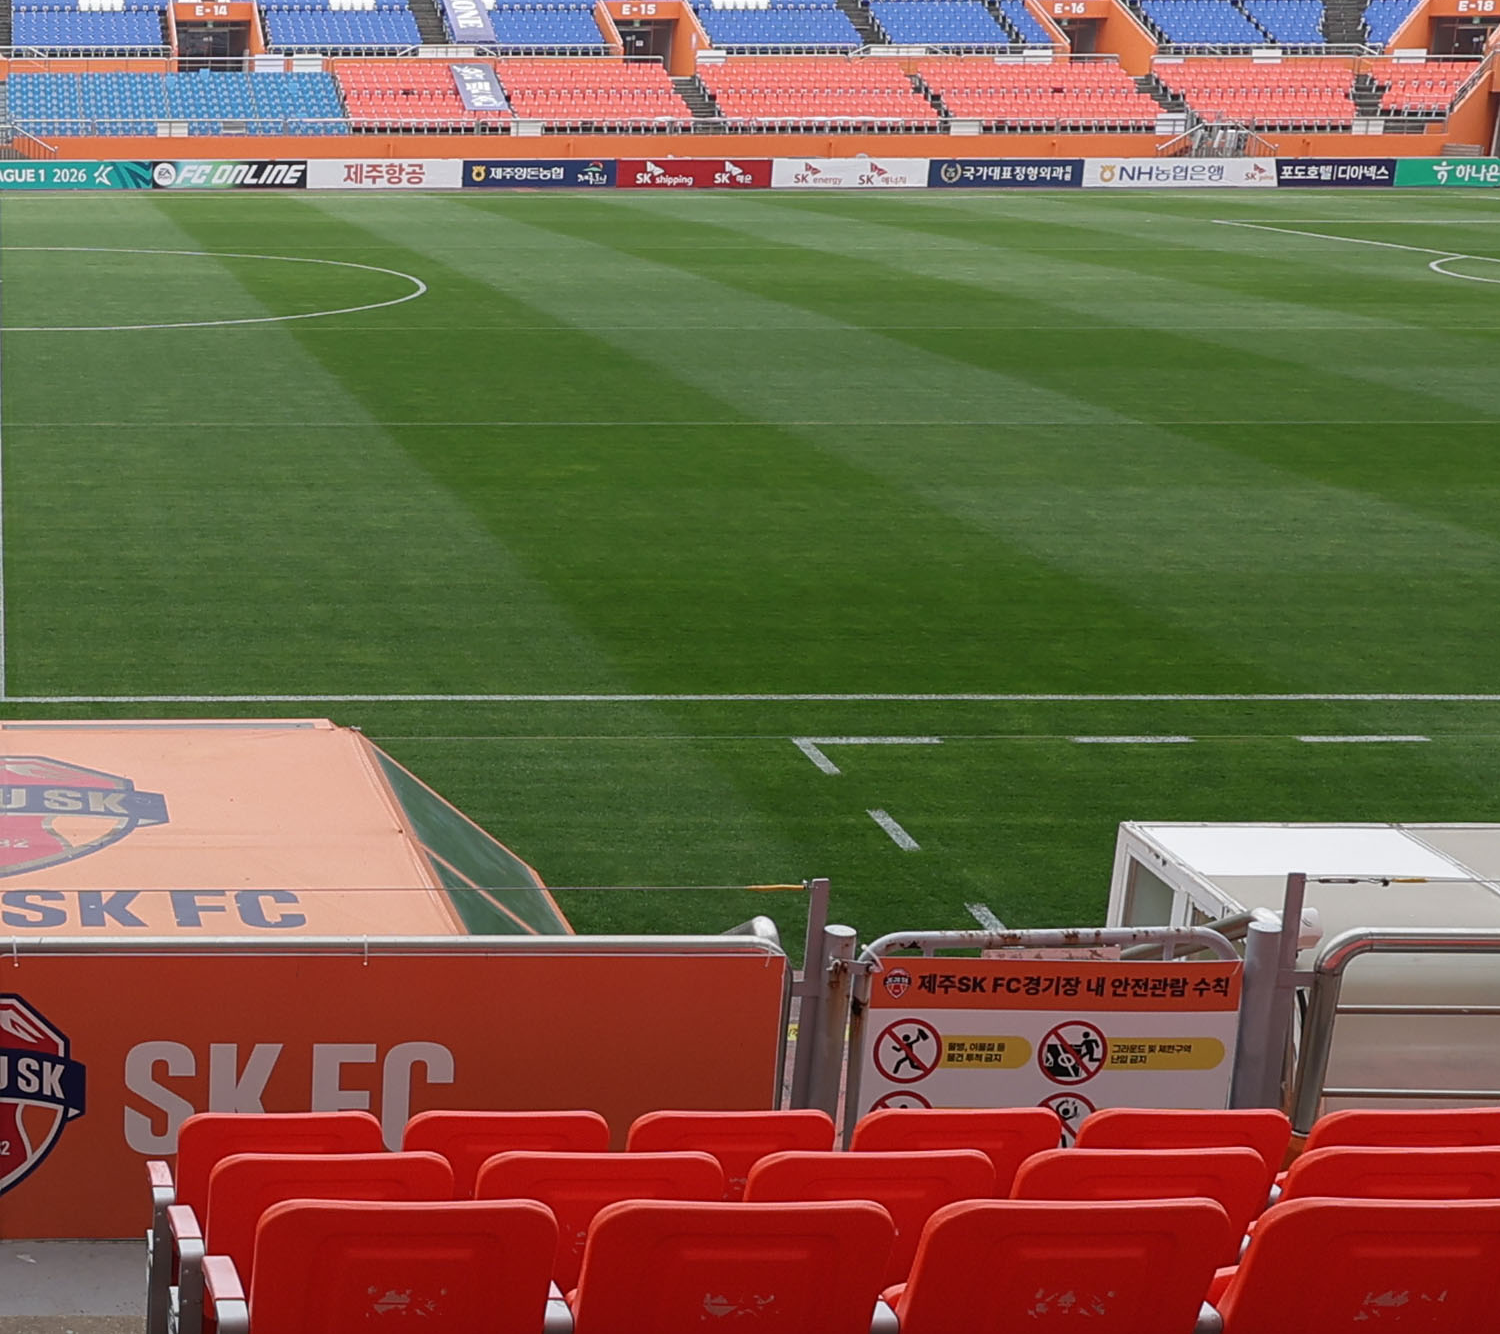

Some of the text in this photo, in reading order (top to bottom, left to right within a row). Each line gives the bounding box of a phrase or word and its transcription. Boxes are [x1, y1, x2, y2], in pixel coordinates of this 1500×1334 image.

[195, 4, 228, 17] E-14
[622, 3, 657, 16] E-15
[1053, 2, 1085, 15] E-16
[1458, 0, 1495, 13] E-18
[53, 168, 87, 184] 2026
[175, 164, 211, 185] FC
[211, 163, 306, 185] ONLINE
[342, 163, 426, 185] 제주항공
[635, 172, 694, 186] SK shipping
[713, 172, 731, 184] SK
[793, 173, 809, 184] SK
[858, 173, 875, 185] SK
[1118, 164, 1225, 182] NH농협은행
[43, 786, 131, 816] SK
[0, 888, 154, 929] SK
[168, 888, 309, 929] FC
[917, 975, 1230, 998] 제주SK FC경기장 내 안전관람 수칙
[16, 1057, 66, 1101] SK
[122, 1040, 285, 1157] SK
[311, 1040, 456, 1153] FC
